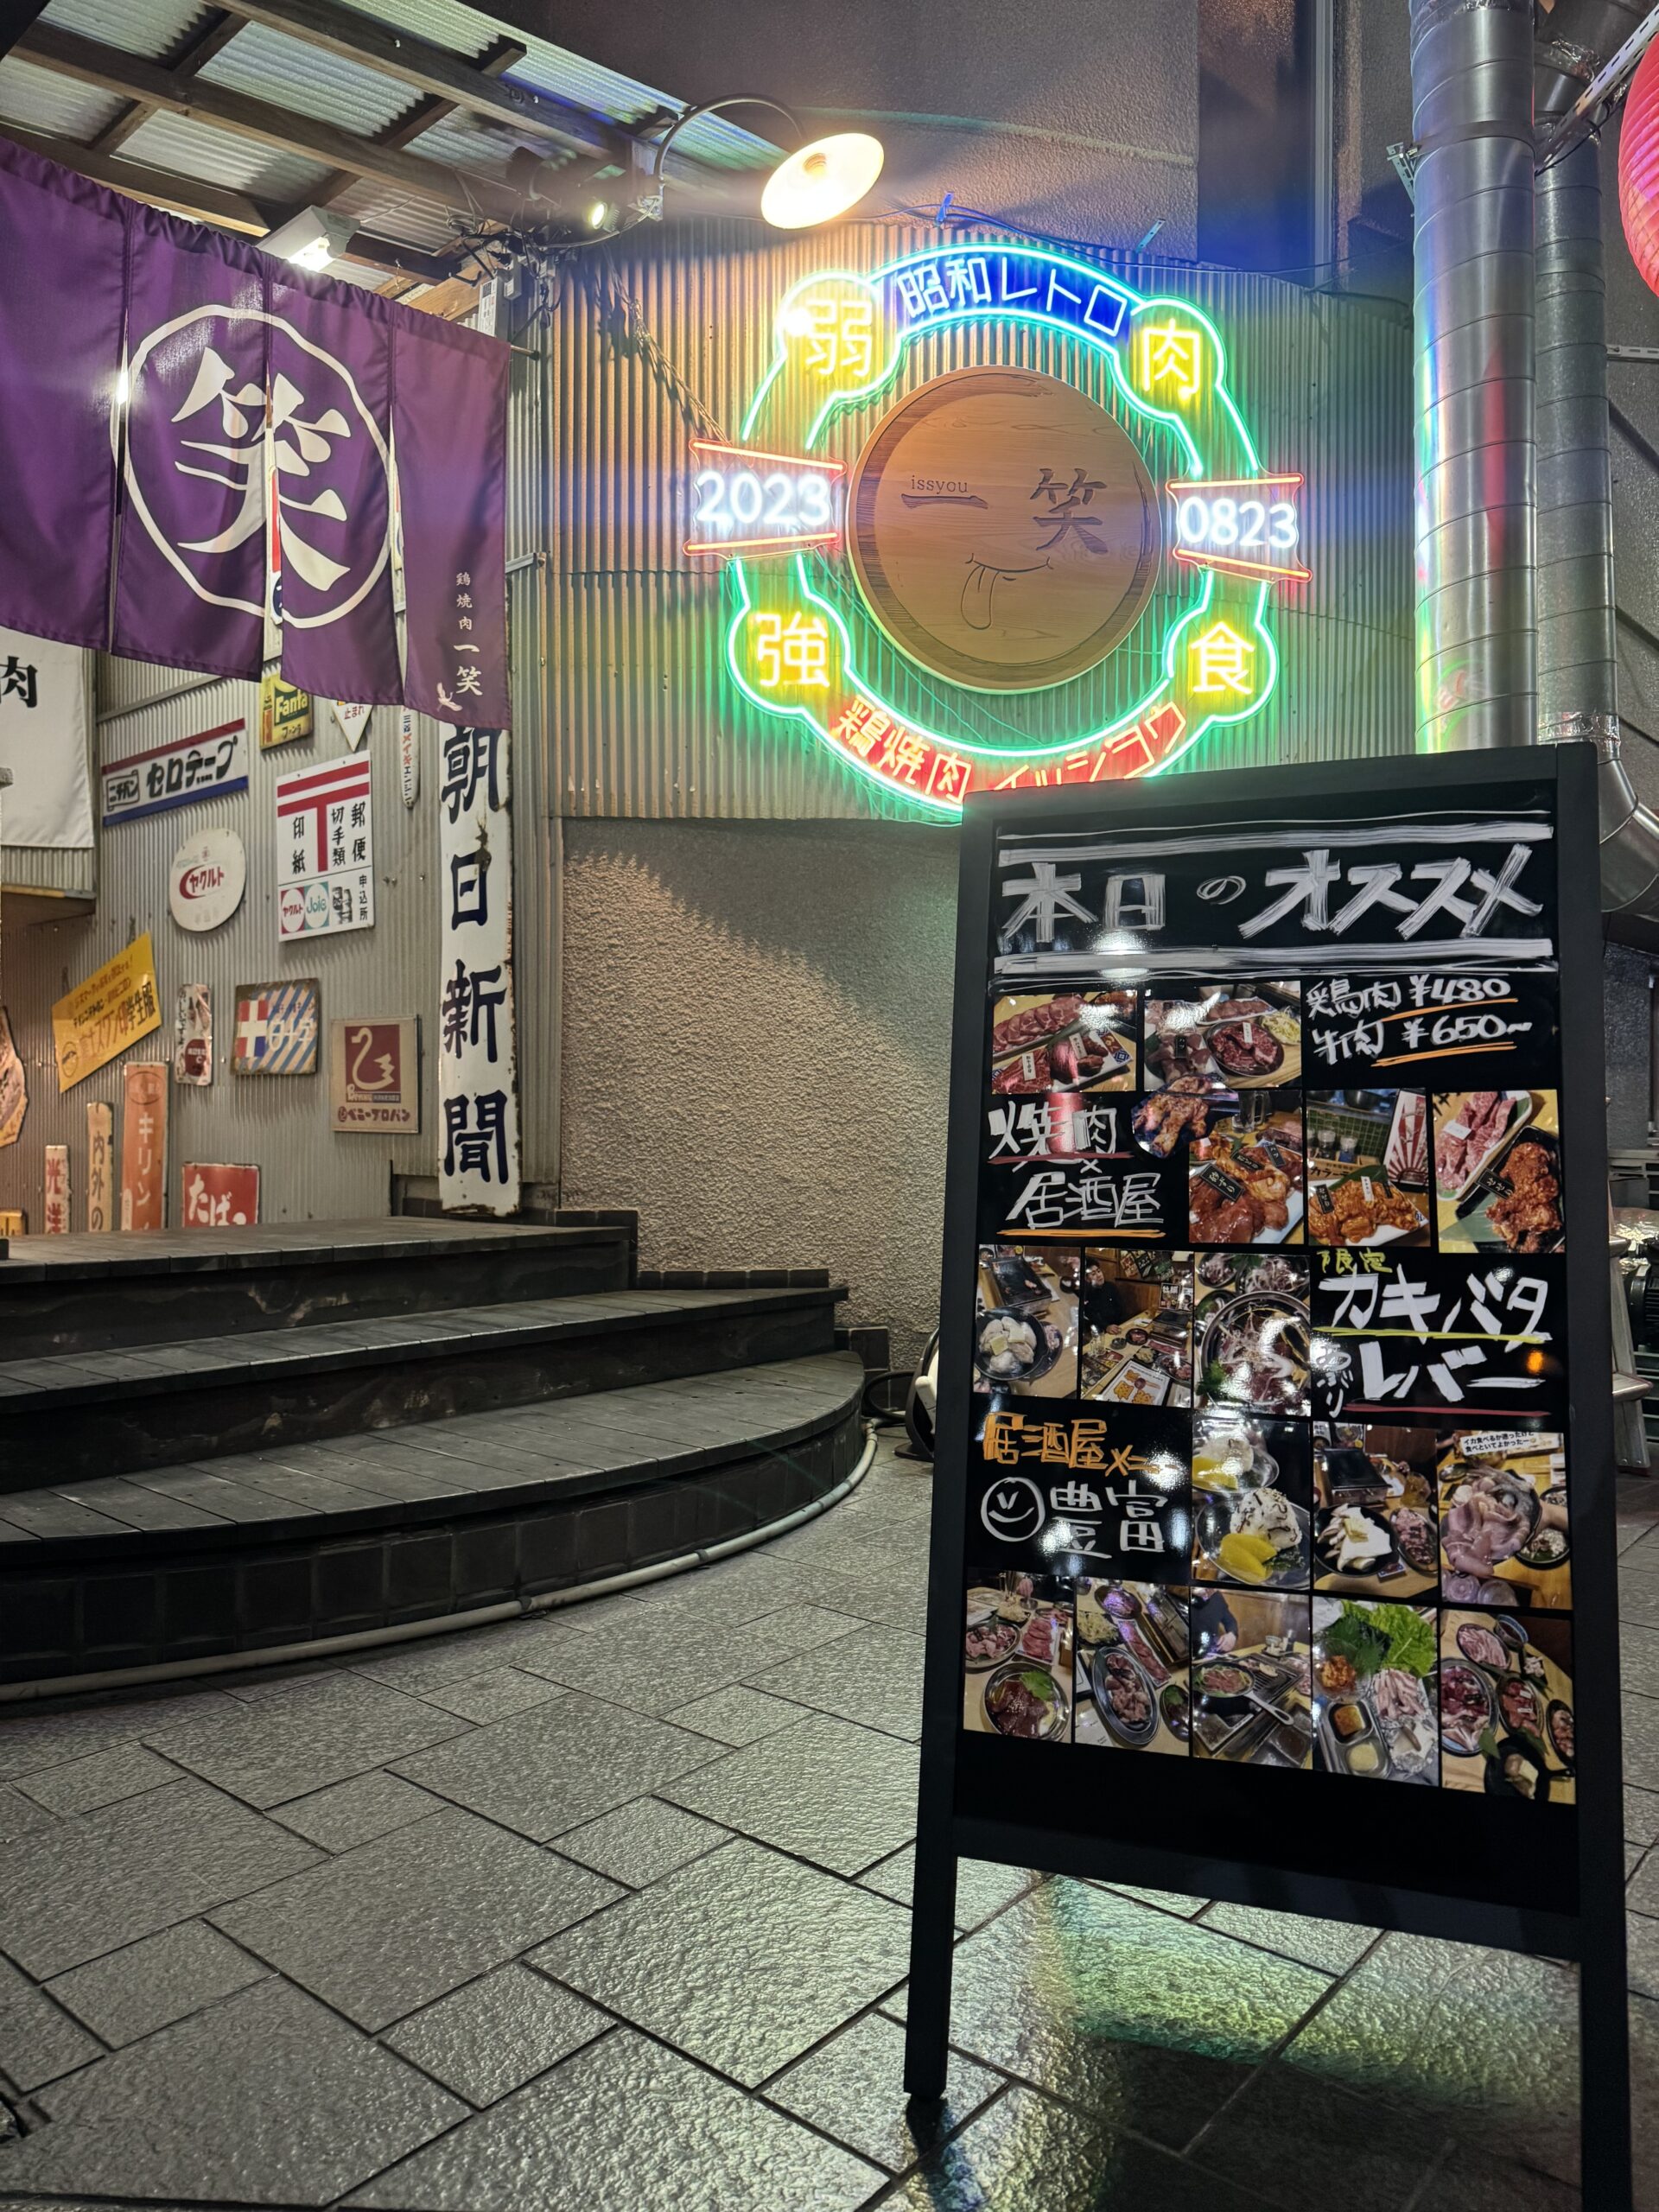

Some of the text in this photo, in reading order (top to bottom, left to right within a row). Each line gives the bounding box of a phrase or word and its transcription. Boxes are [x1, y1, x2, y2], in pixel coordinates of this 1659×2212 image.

[897, 257, 1128, 338] 昭和レトロ
[804, 296, 874, 378] 弱
[1142, 318, 1202, 397] 肉
[170, 346, 351, 591] 笑
[696, 470, 832, 526] 2023
[911, 474, 969, 495] issyou
[1176, 494, 1299, 550] 0823
[453, 571, 483, 696] 鶏焼肉 一笑
[755, 611, 831, 688] 強
[1191, 621, 1255, 694] 食
[275, 690, 308, 724] Fanta
[282, 724, 302, 740] ファンタ
[146, 735, 238, 798] セロテープ
[836, 696, 971, 804] 鶏焼肉
[109, 779, 138, 803] ニチバン
[292, 816, 306, 874] 印紙
[331, 806, 346, 866] 切手類
[351, 801, 366, 862] 郵便
[189, 866, 225, 893] ヤクルト
[283, 903, 303, 916] ヤクルト
[359, 874, 368, 920] 申込所
[1001, 844, 1543, 942] 本日のオススメ
[441, 724, 509, 1184] 朝日新聞
[1306, 974, 1511, 1020] 鶏肉 ¥480
[1312, 1018, 1383, 1065] 牛肉
[988, 1100, 1117, 1173] 焼肉
[188, 1173, 248, 1226] たば
[1005, 1171, 1164, 1230] 居酒屋
[1316, 1248, 1393, 1274] 限定
[1318, 1262, 1554, 1353] カキバタ
[1358, 1340, 1547, 1403] レバー
[1049, 1479, 1169, 1560] 豊富
